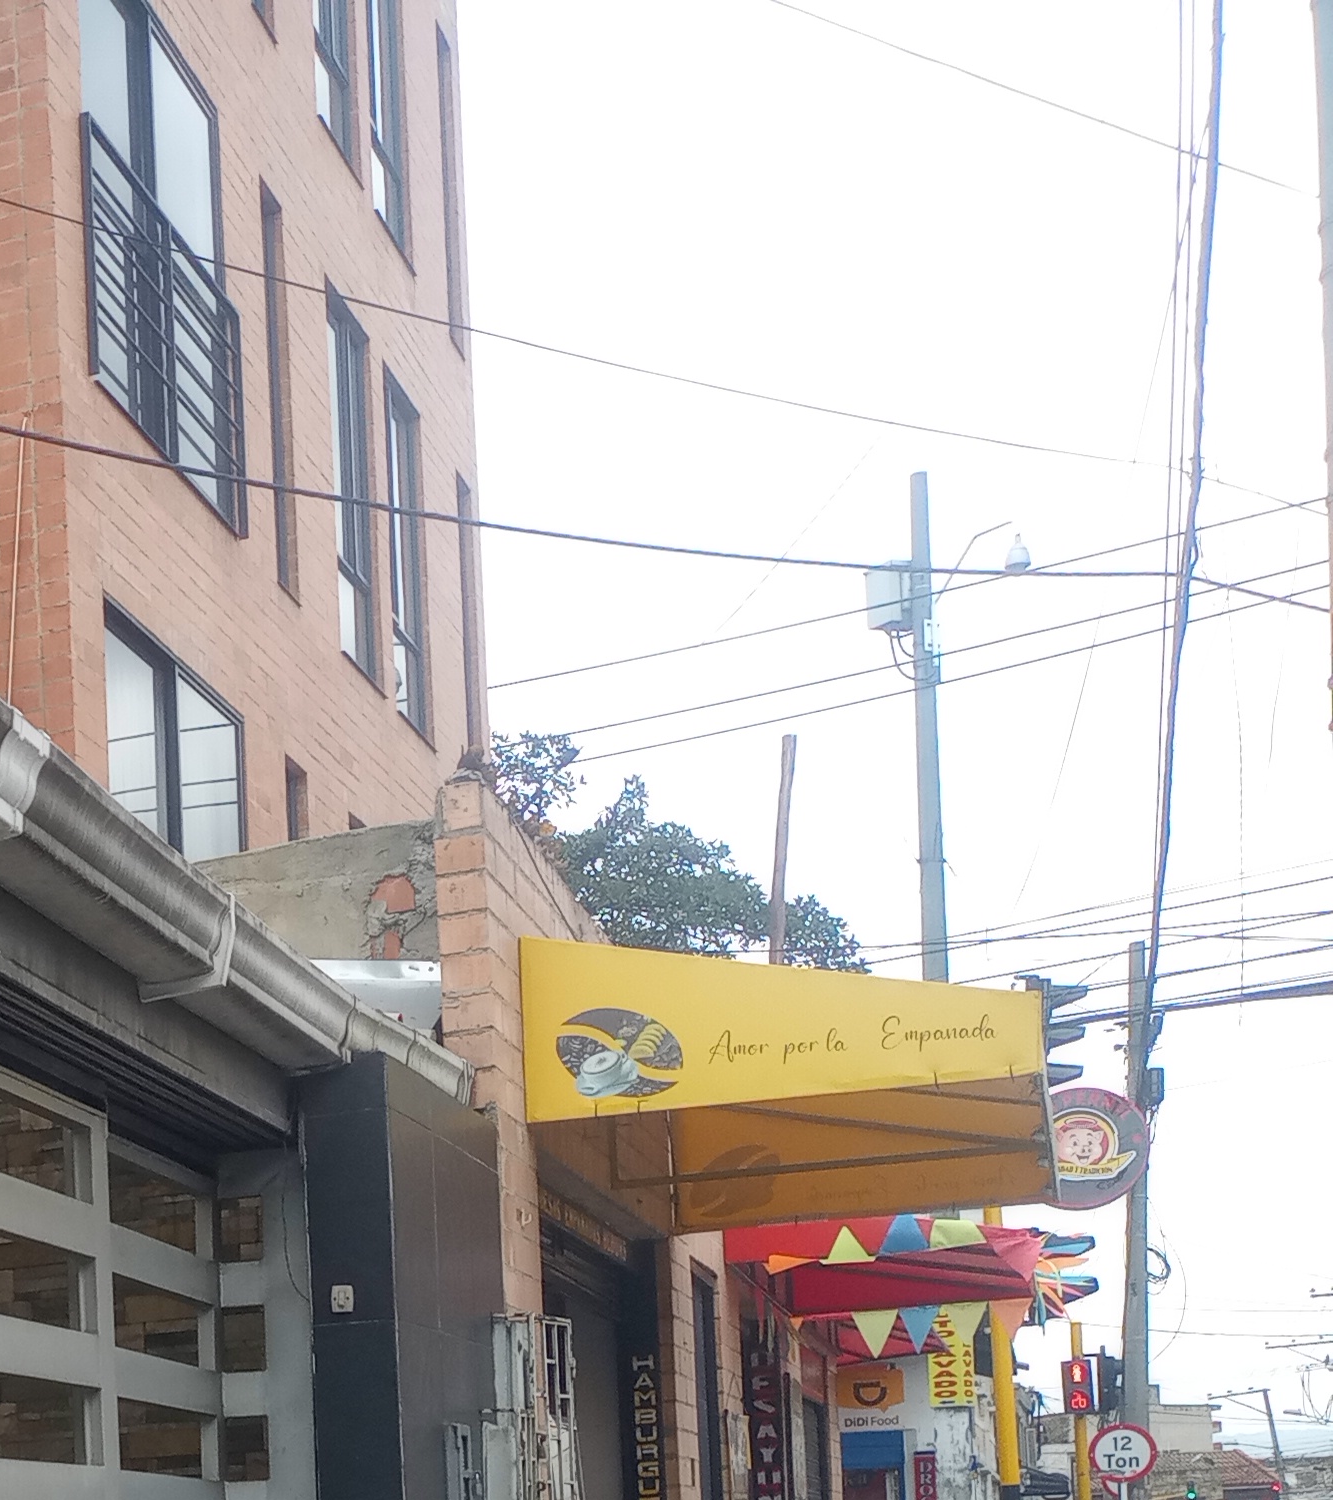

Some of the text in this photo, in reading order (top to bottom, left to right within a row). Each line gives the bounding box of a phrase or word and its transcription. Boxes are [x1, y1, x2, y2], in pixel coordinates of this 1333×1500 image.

[708, 1013, 999, 1065] Amor por la Empanada
[844, 1414, 899, 1428] DiDi Food
[1112, 1436, 1133, 1452] 12
[1102, 1453, 1140, 1469] Ton
